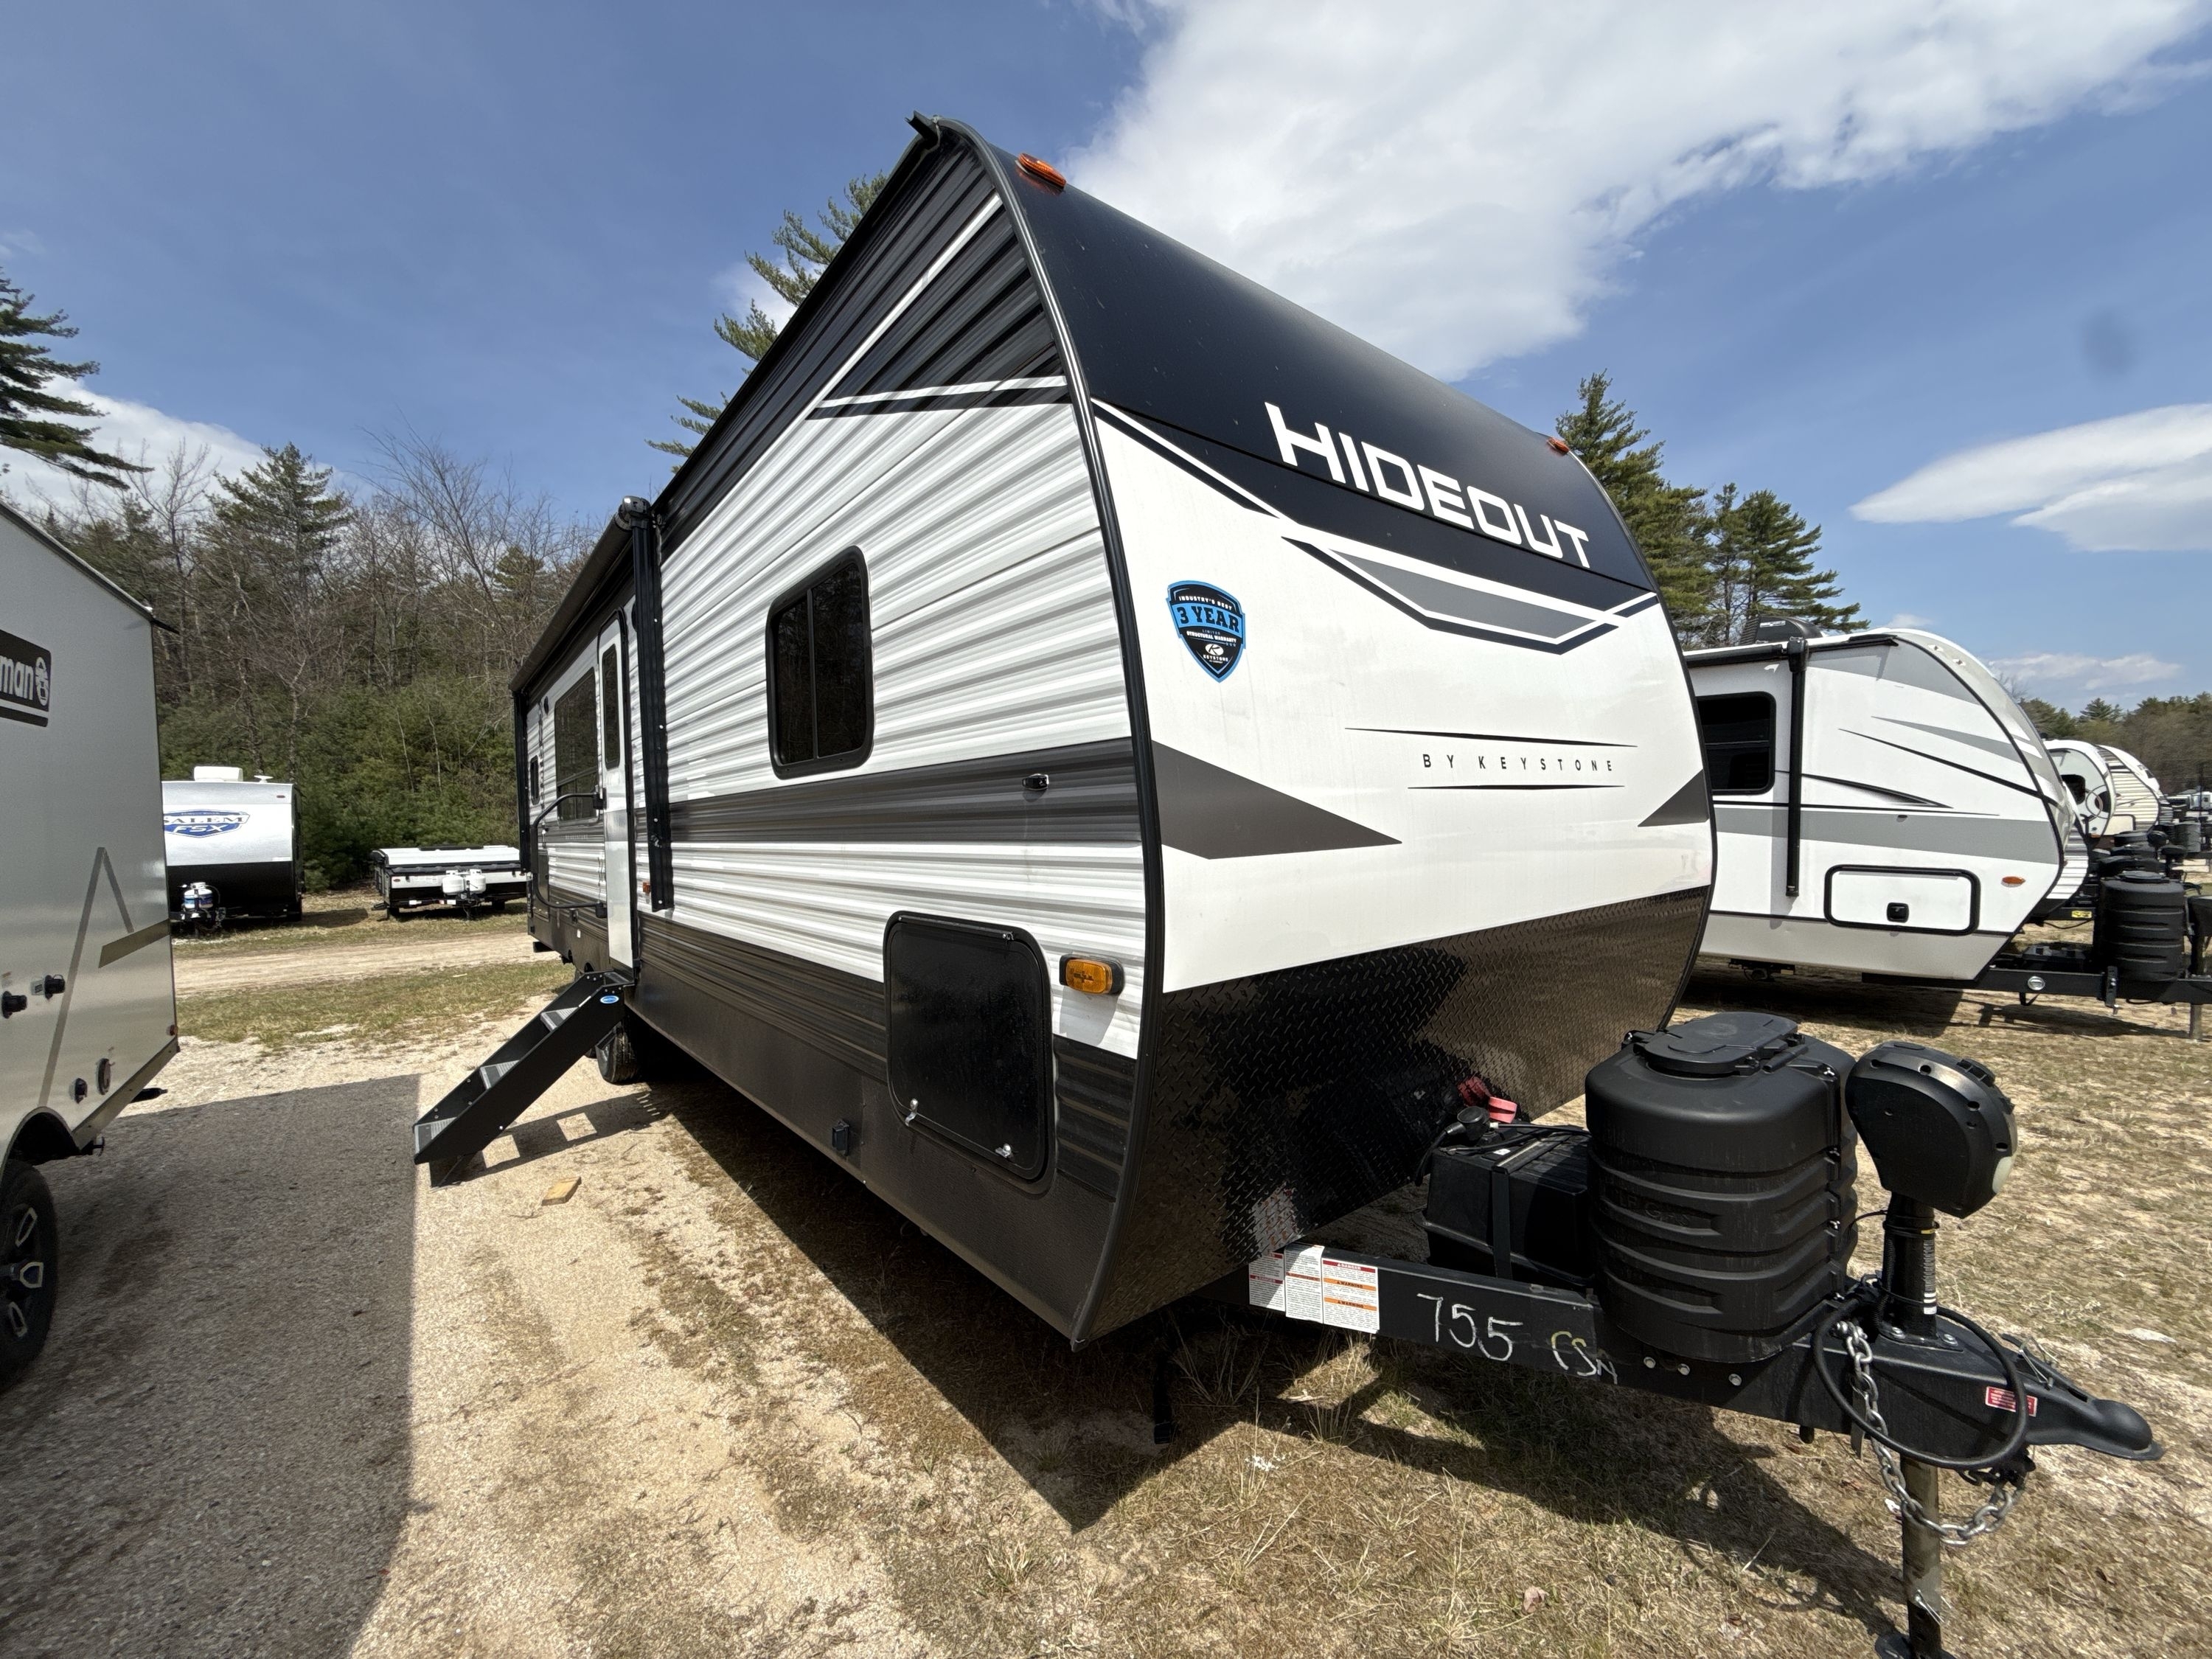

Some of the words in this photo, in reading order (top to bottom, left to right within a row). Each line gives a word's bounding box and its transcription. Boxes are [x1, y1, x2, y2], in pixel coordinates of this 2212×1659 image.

[1265, 402, 1590, 568] HIDEOUT
[1177, 606, 1189, 624] 3
[1191, 605, 1239, 633] YEAR
[1422, 754, 1454, 768] BY
[1478, 755, 1613, 772] KEYSTONE
[173, 824, 229, 833] FSX
[1340, 1281, 1363, 1289] WARNING
[1416, 1293, 1523, 1361] 755
